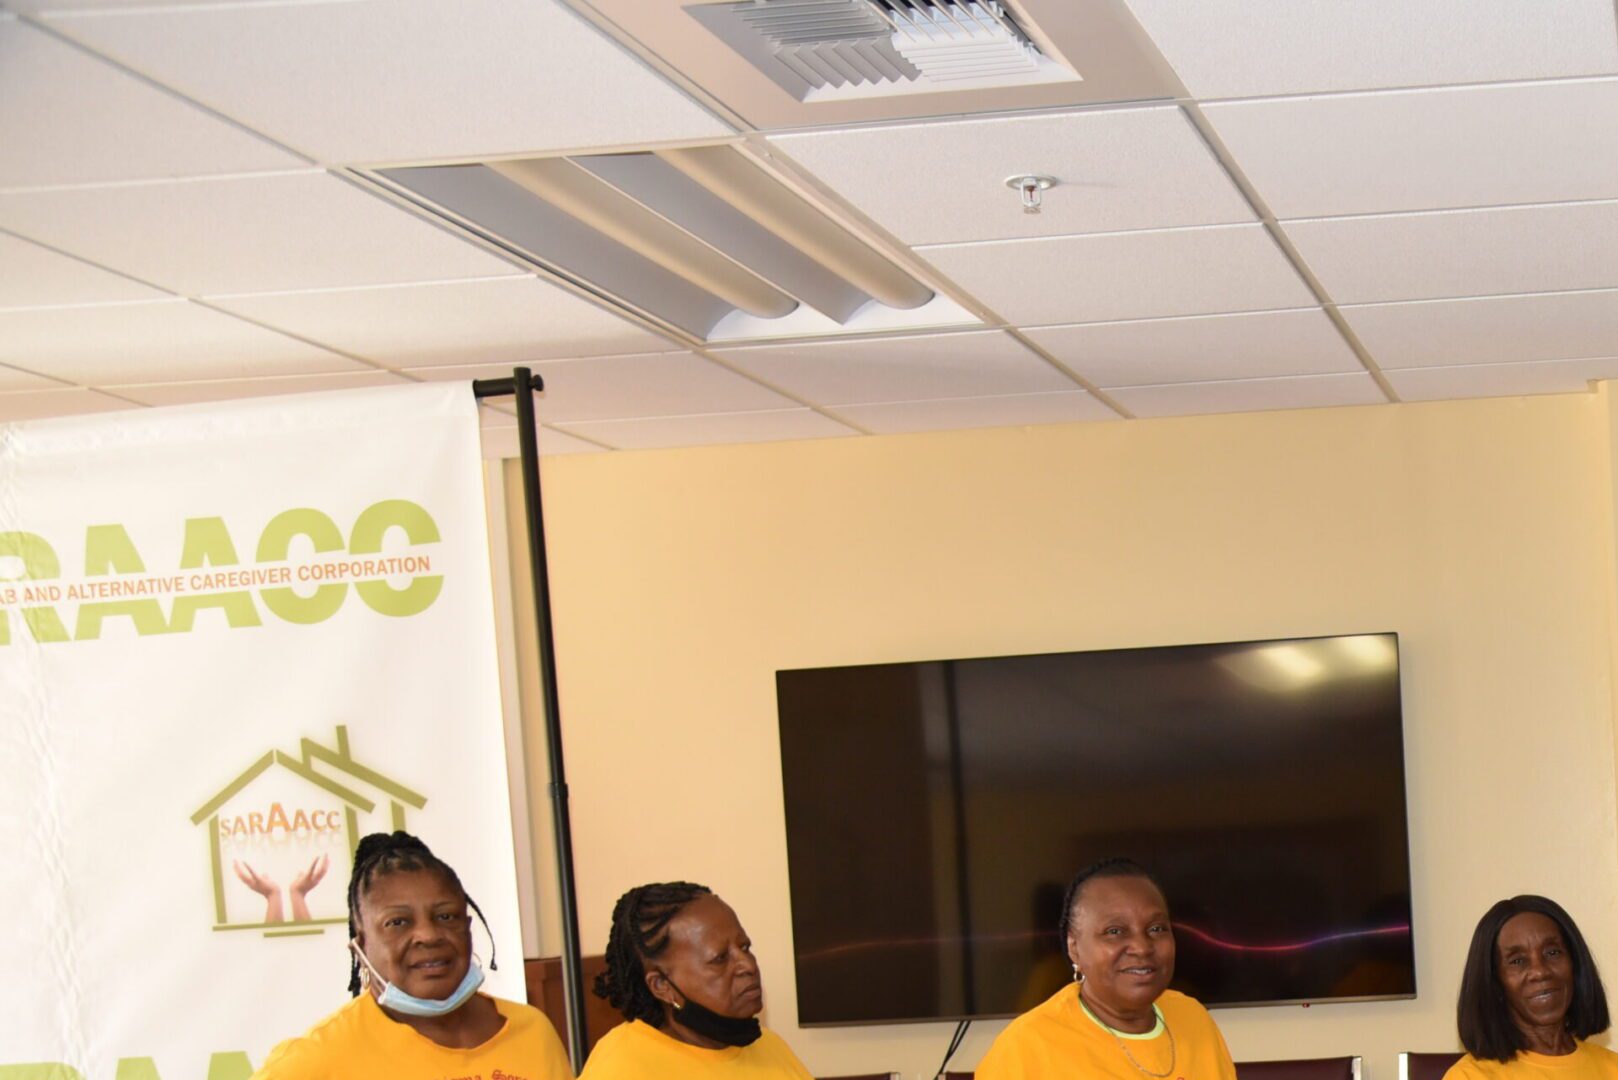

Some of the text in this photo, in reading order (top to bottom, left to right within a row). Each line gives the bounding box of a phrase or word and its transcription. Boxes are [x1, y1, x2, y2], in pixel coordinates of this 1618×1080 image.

[24, 585, 61, 602] AND
[67, 576, 185, 600] ALTERNATIVE
[190, 567, 291, 591] CAREGIVER
[297, 556, 431, 582] CORPORATION
